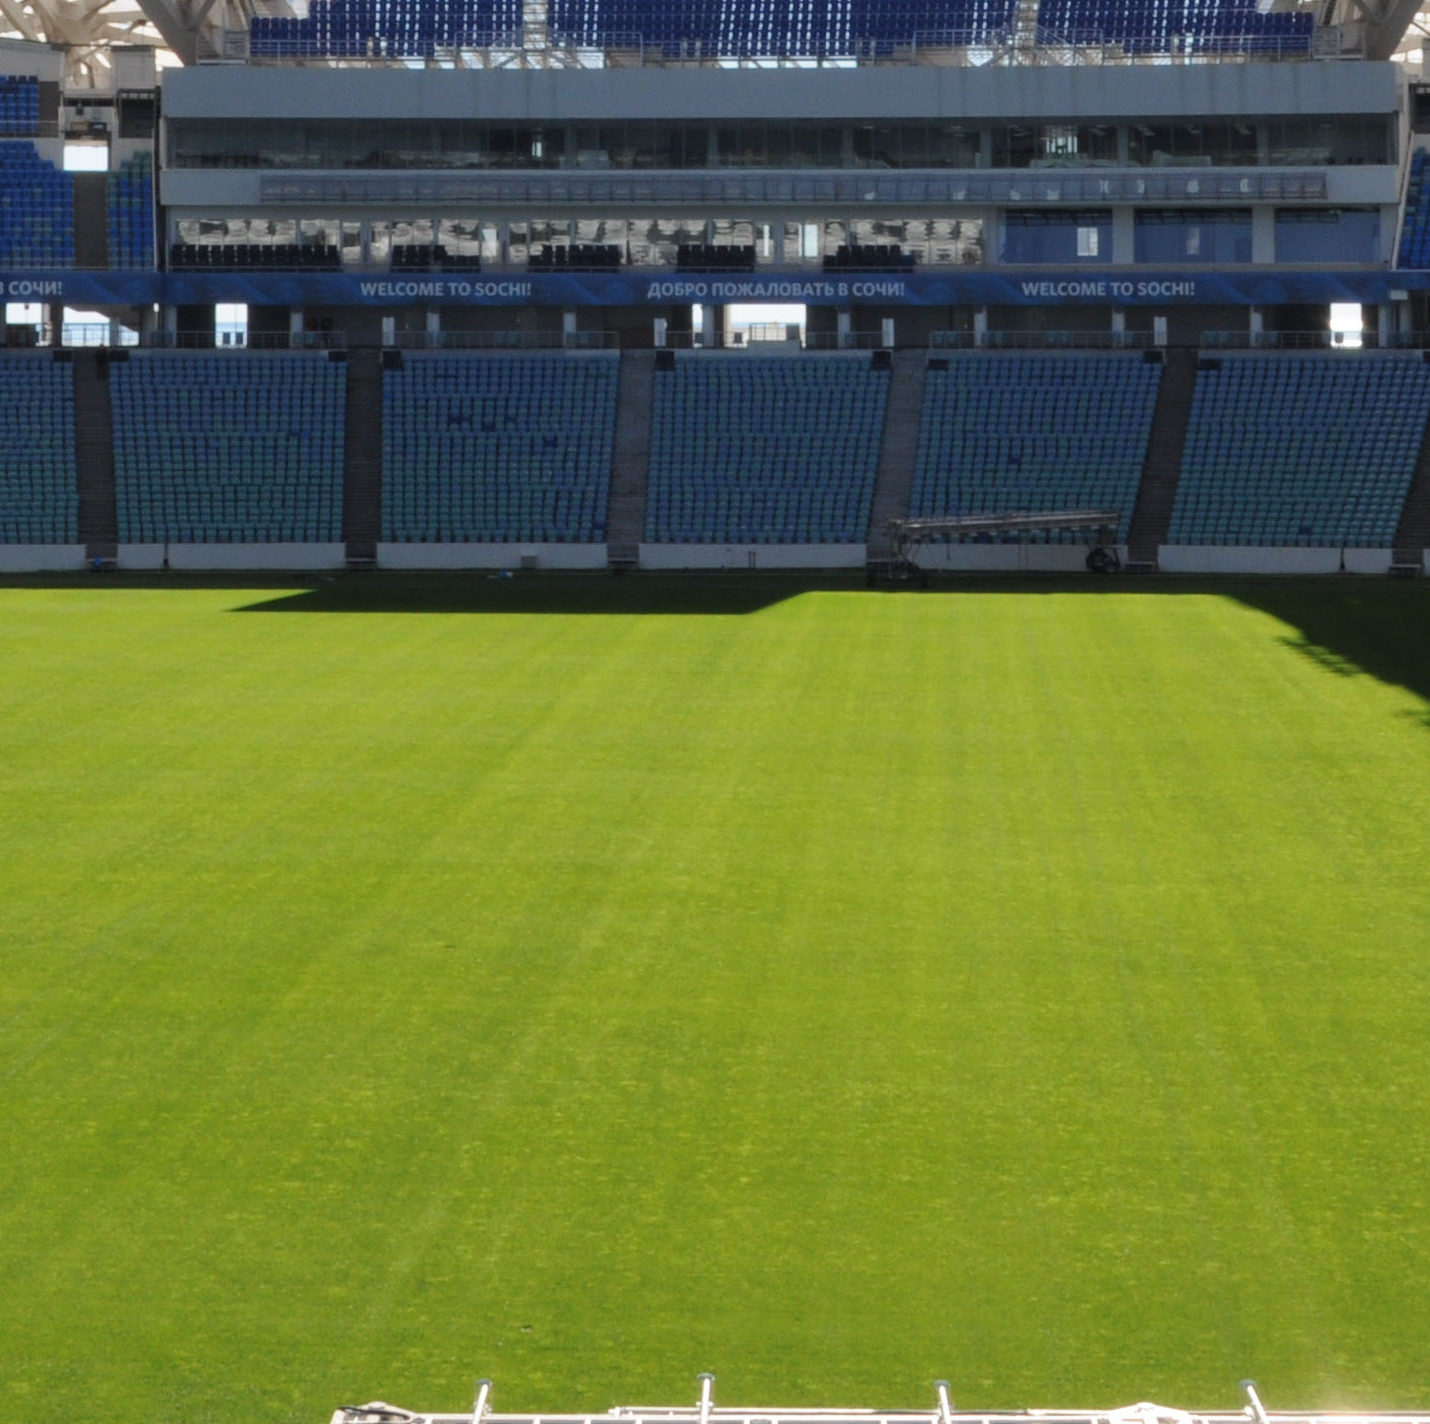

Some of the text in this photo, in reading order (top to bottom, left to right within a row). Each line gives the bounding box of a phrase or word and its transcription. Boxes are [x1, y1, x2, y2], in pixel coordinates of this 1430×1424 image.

[8, 280, 63, 296] СОЧИ!
[360, 281, 532, 297] WELCOME TO SOCHI!
[647, 282, 905, 299] ДОБРО ПОЖАЛОВАТЬ В СОЧИ!
[1021, 281, 1195, 297] WELCOME TO SOCHI!
